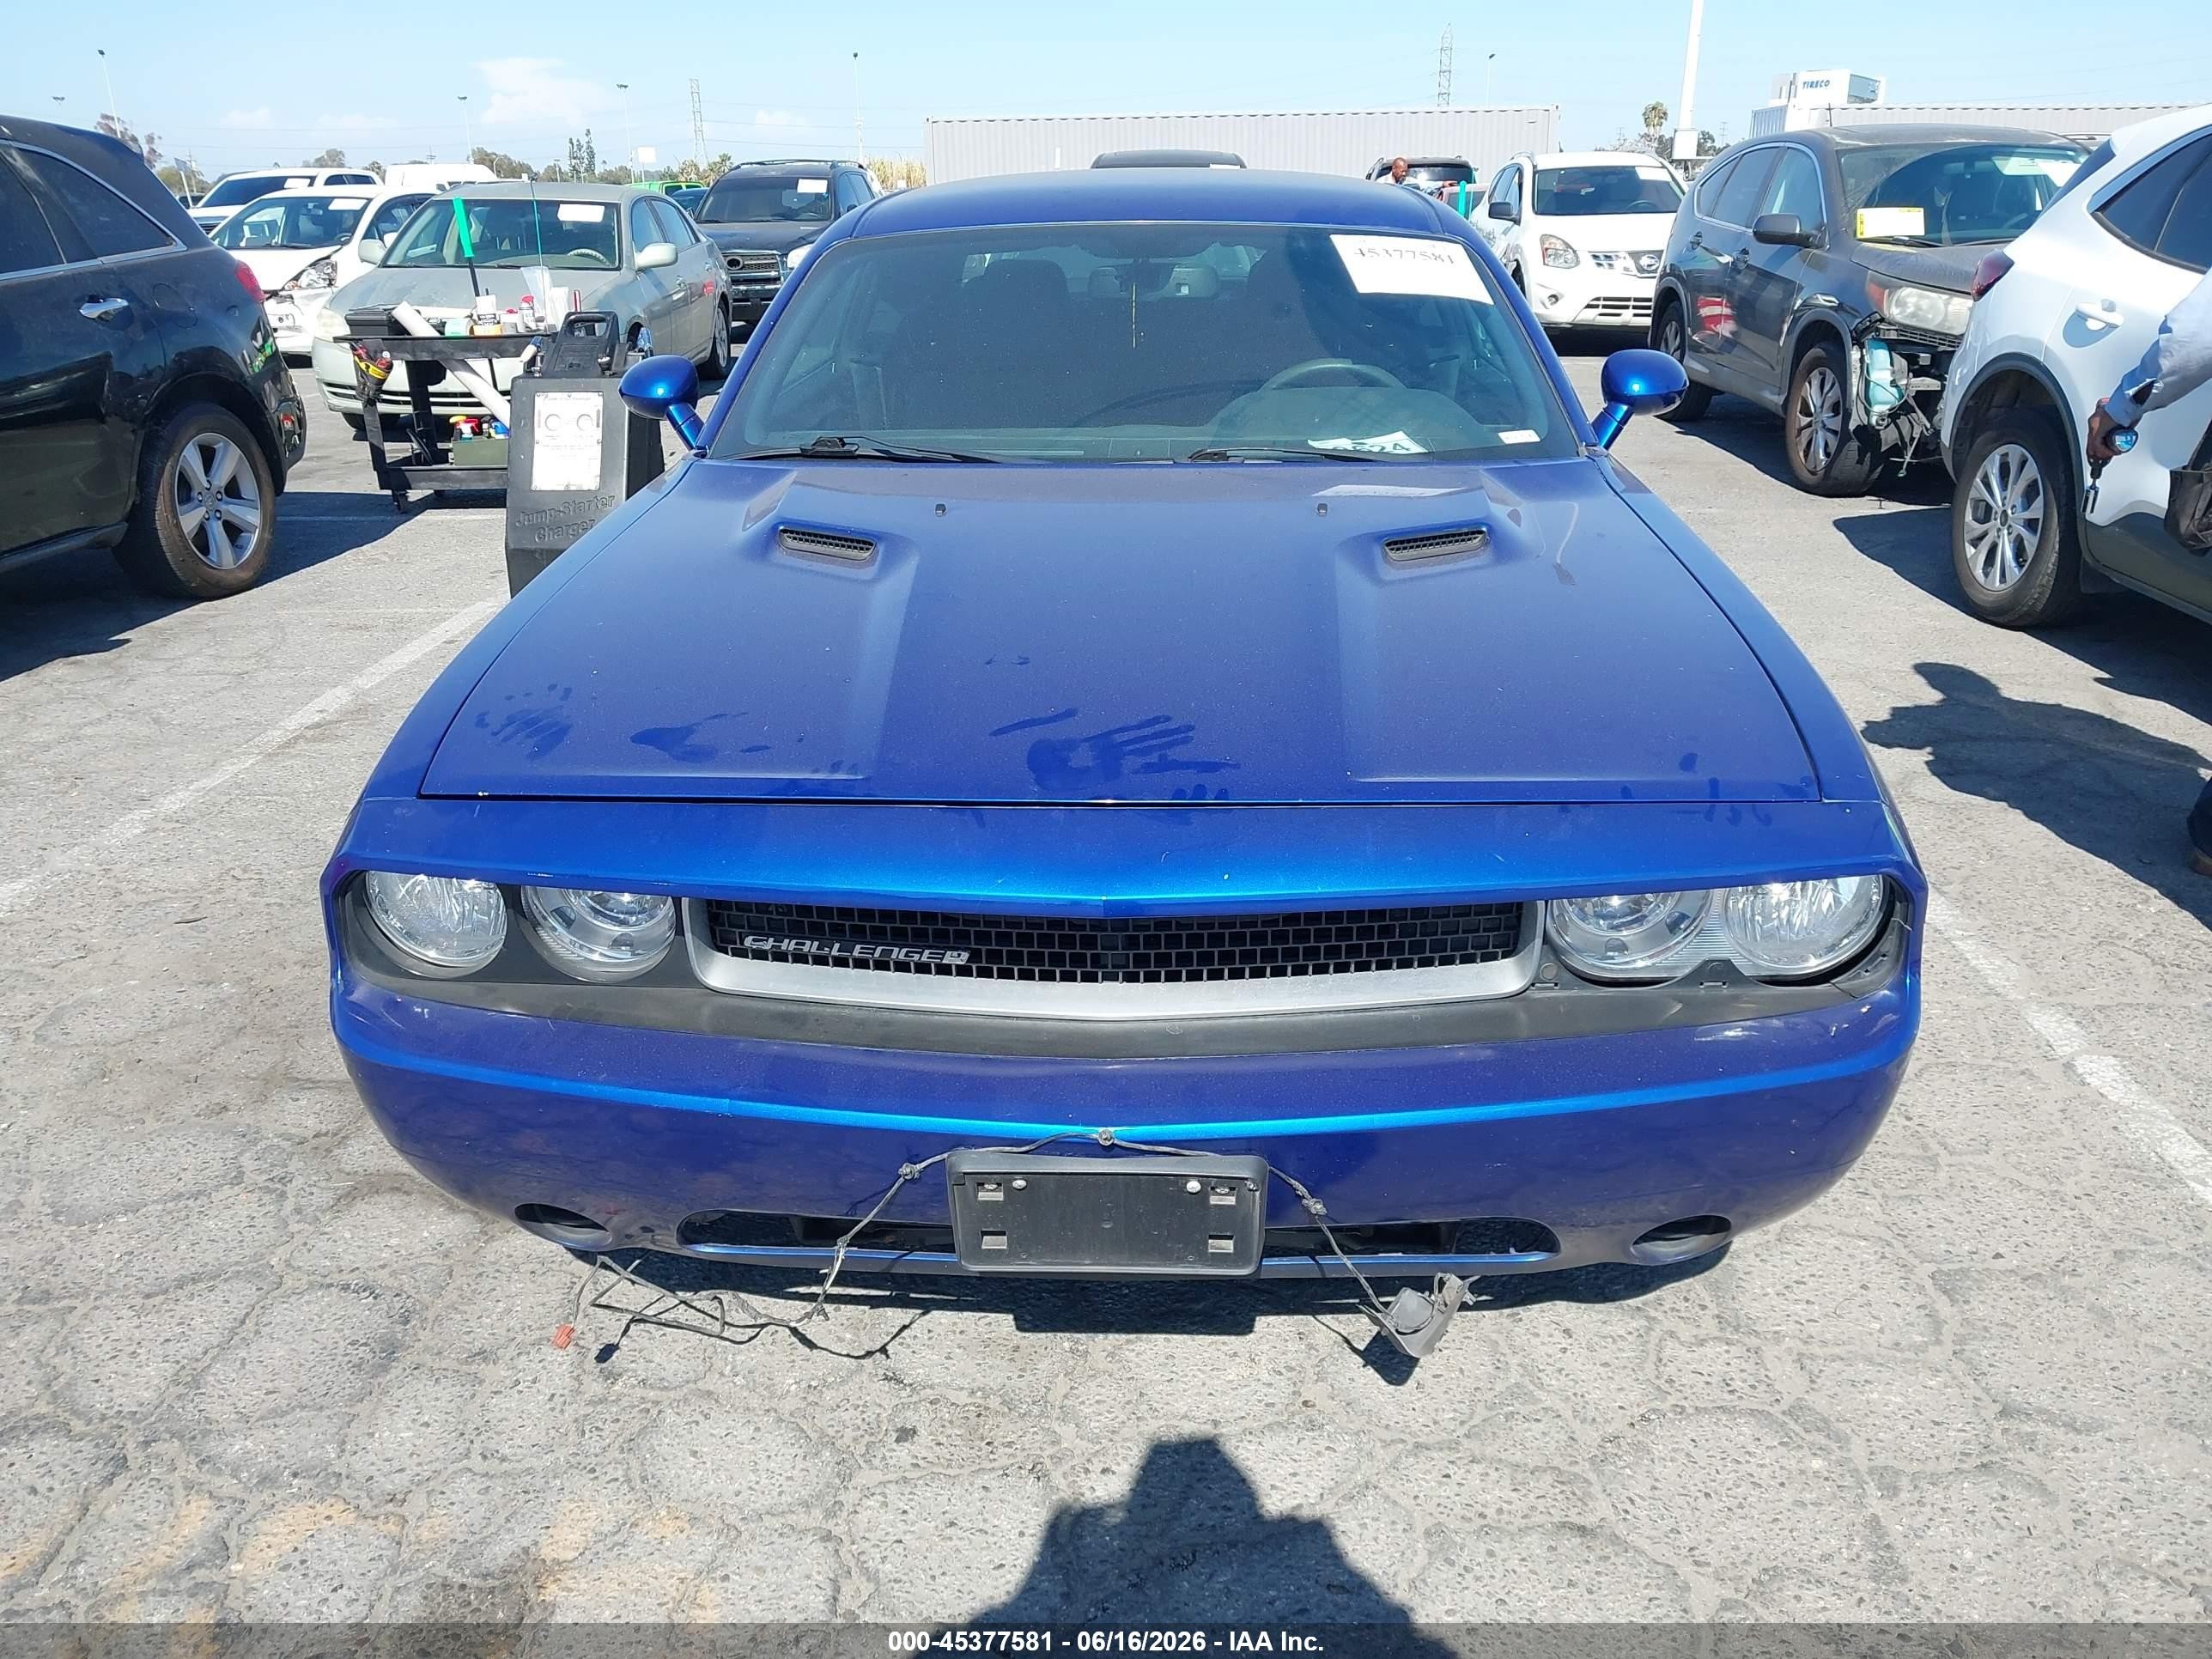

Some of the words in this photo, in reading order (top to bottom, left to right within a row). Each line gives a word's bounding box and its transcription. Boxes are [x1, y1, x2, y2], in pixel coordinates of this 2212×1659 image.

[1802, 79, 1831, 89] TIRECO
[534, 519, 596, 543] Charger
[743, 935, 971, 965] CHALLENGER
